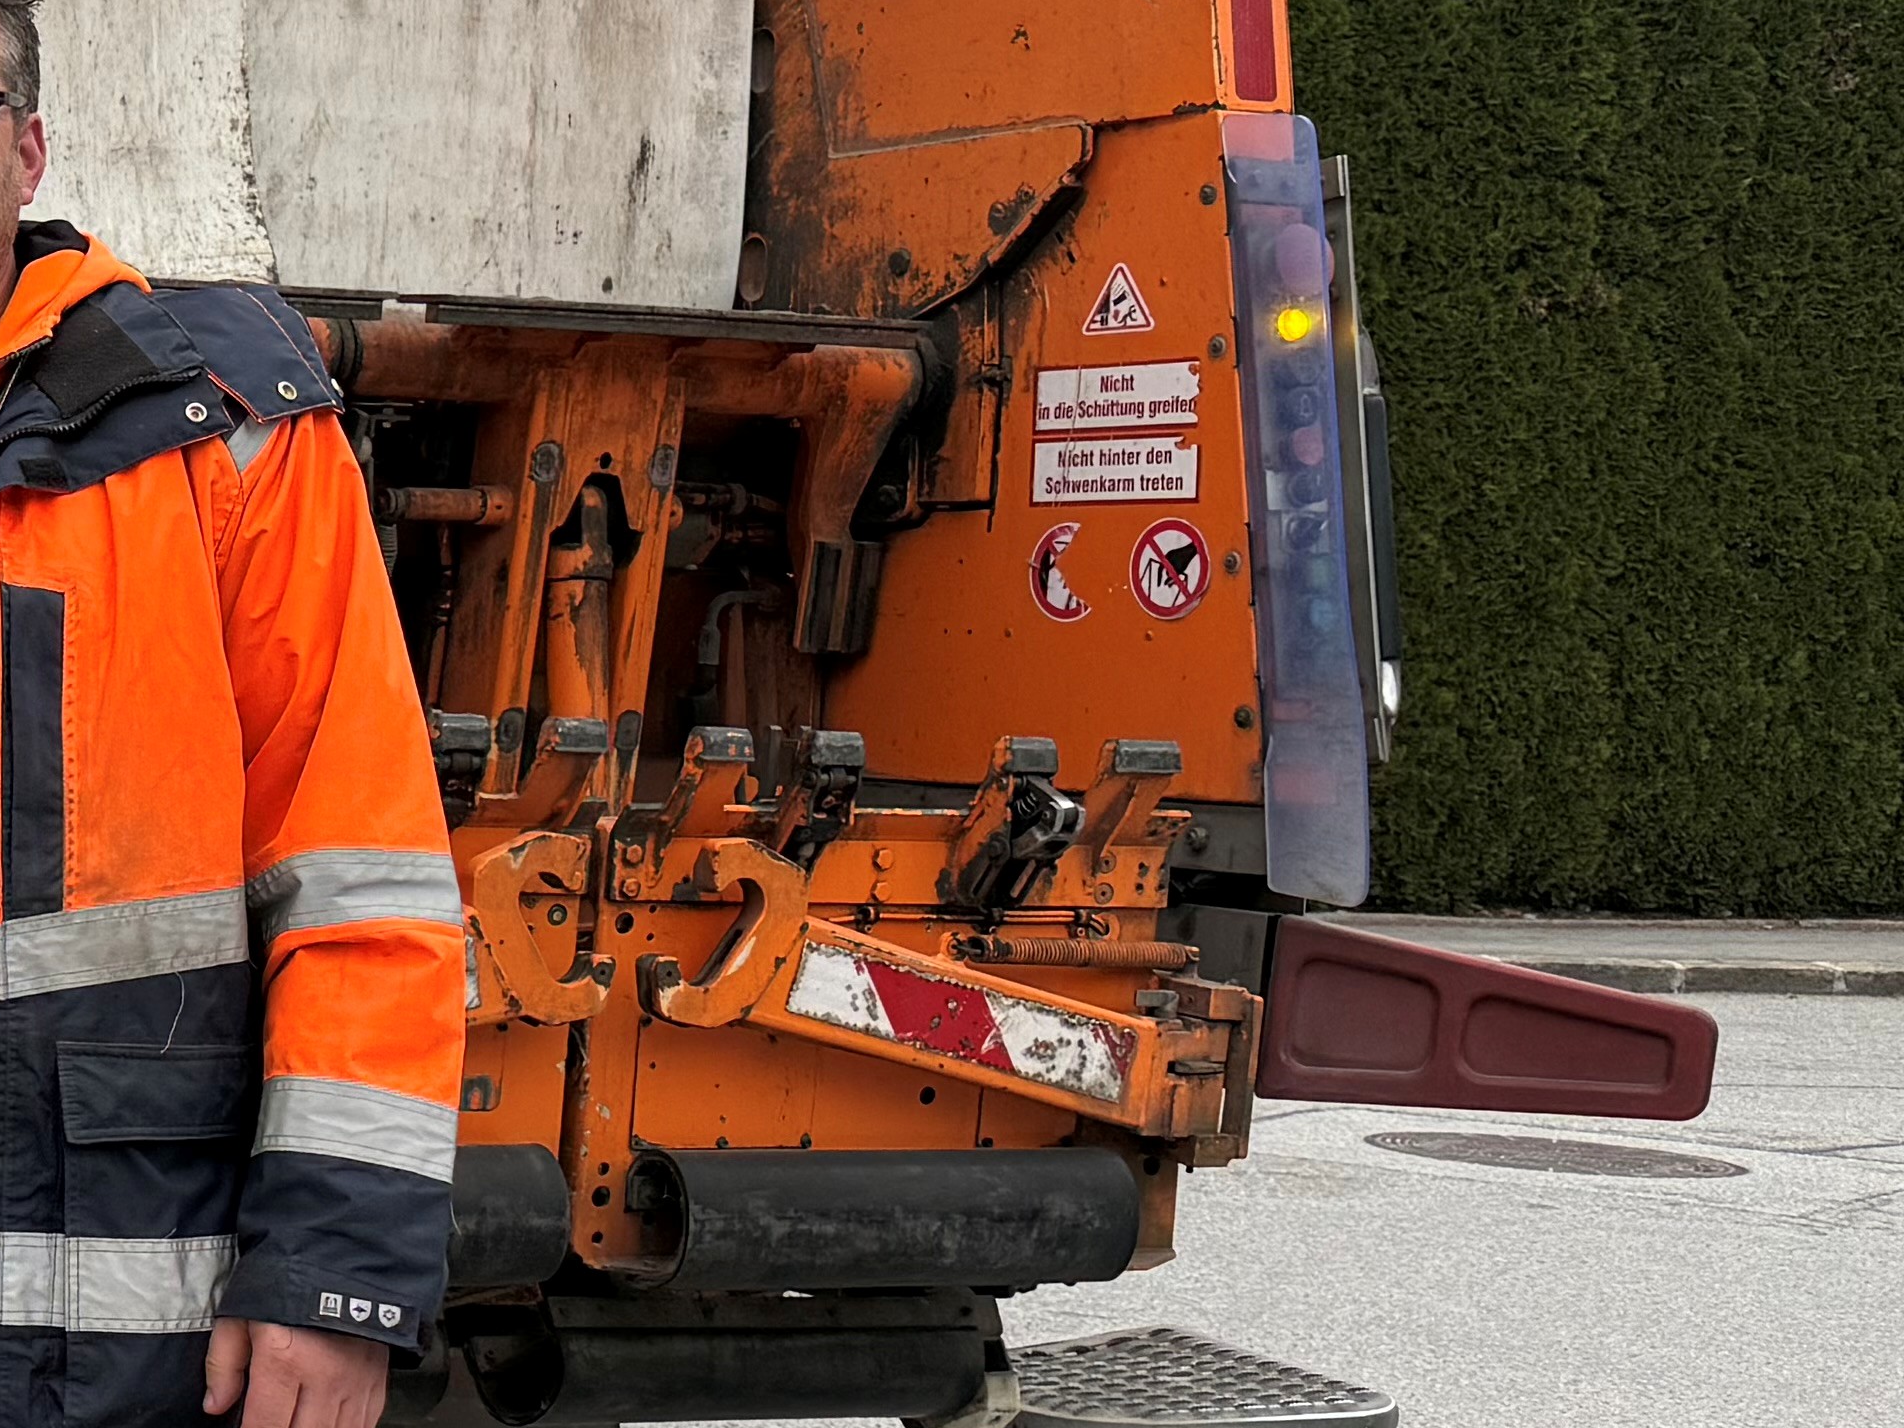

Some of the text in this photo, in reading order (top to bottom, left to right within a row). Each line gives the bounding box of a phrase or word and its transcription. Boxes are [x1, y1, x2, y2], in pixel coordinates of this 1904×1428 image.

[1099, 374, 1135, 393] Nicht
[1037, 402, 1050, 420] in
[1053, 401, 1074, 420] die
[1078, 399, 1145, 419] Schüttung
[1058, 446, 1173, 468] Nicht hinter den
[1045, 473, 1184, 495] Schwenkarm treten
